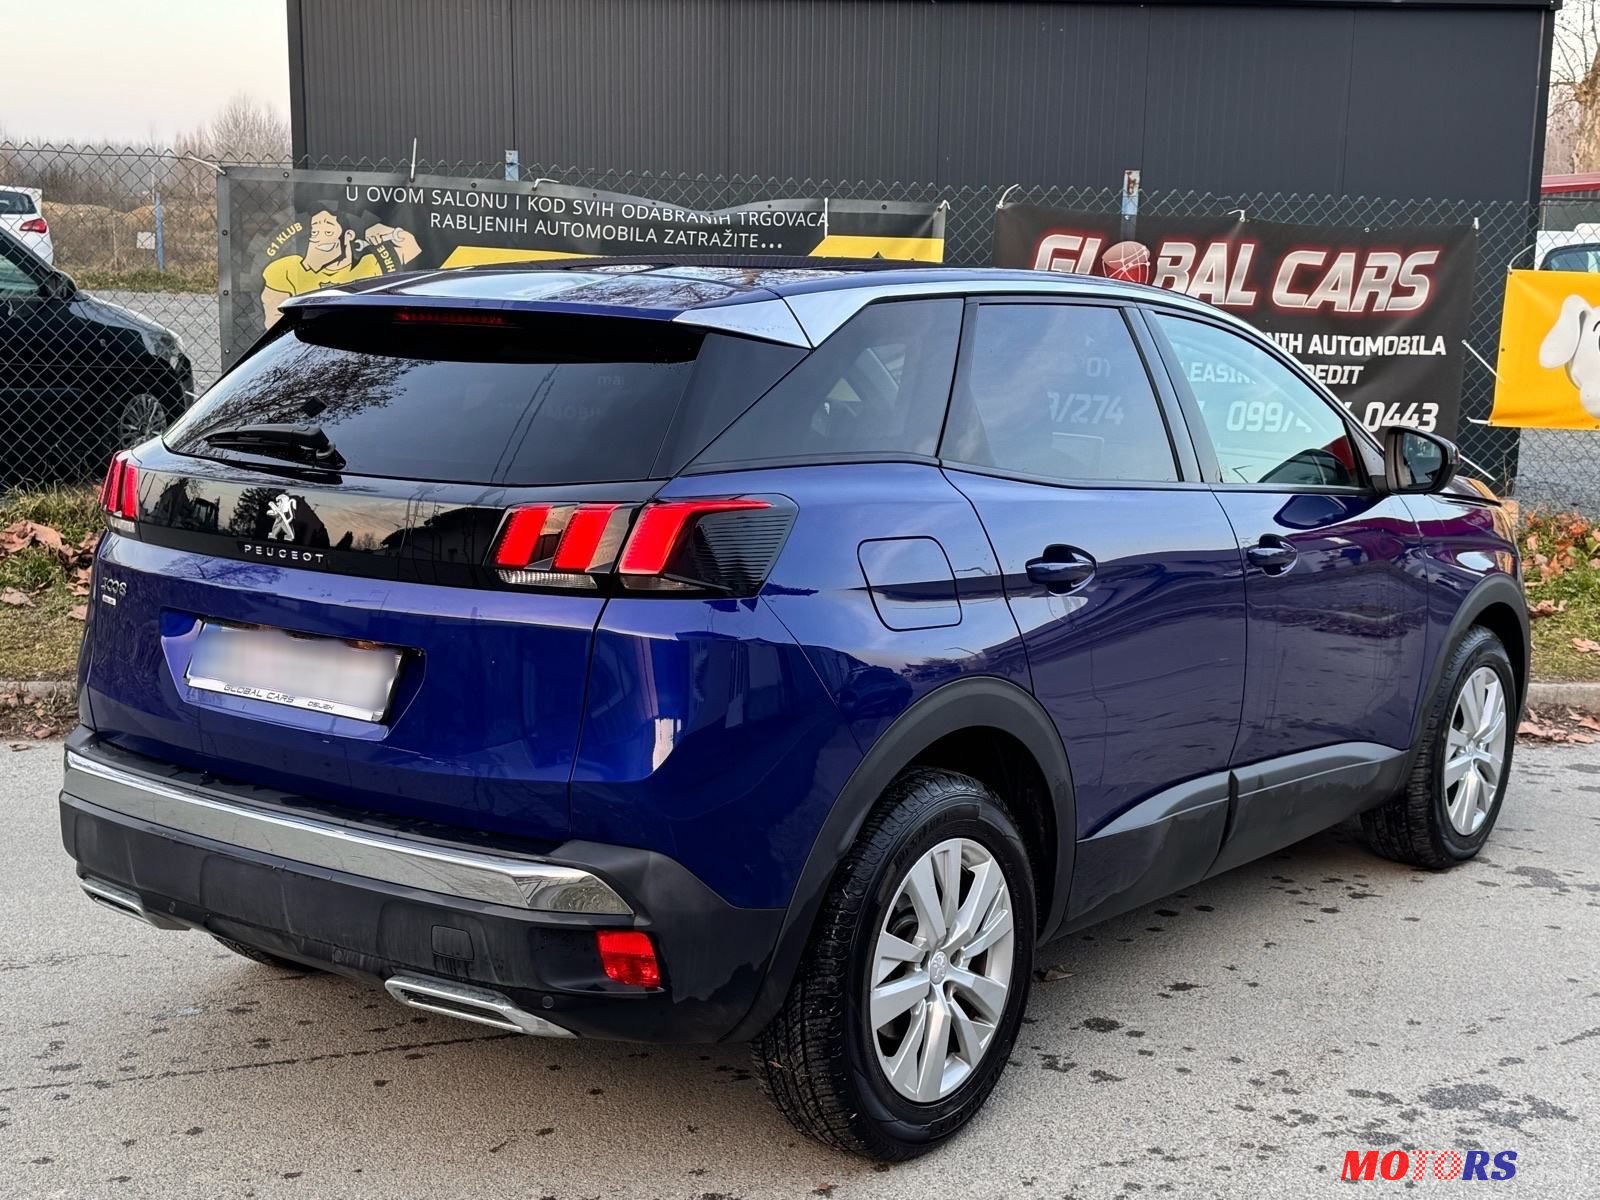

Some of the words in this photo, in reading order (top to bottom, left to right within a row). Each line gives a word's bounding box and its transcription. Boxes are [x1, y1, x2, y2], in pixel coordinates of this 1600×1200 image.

[346, 186, 359, 202] U
[366, 186, 424, 204] OVOM
[431, 189, 508, 210] SALONU
[515, 195, 520, 211] I
[527, 196, 566, 213] KOD
[572, 200, 614, 217] SVIH
[621, 204, 731, 225] ODABRANIH
[737, 211, 829, 227] TRGOVACA
[266, 241, 280, 257] G1
[275, 222, 303, 245] KLUB
[430, 212, 528, 234] RABLJENIH
[534, 219, 658, 243] AUTOMOBILA
[664, 228, 783, 249] ZATRAŽITE...
[1272, 250, 1440, 312] CARS
[1307, 333, 1447, 356] AUTOMOBILA
[1363, 401, 1440, 433] 0443
[244, 544, 324, 563] PEUGEOT
[223, 683, 263, 698] GLOBAL
[266, 692, 296, 704] CARS
